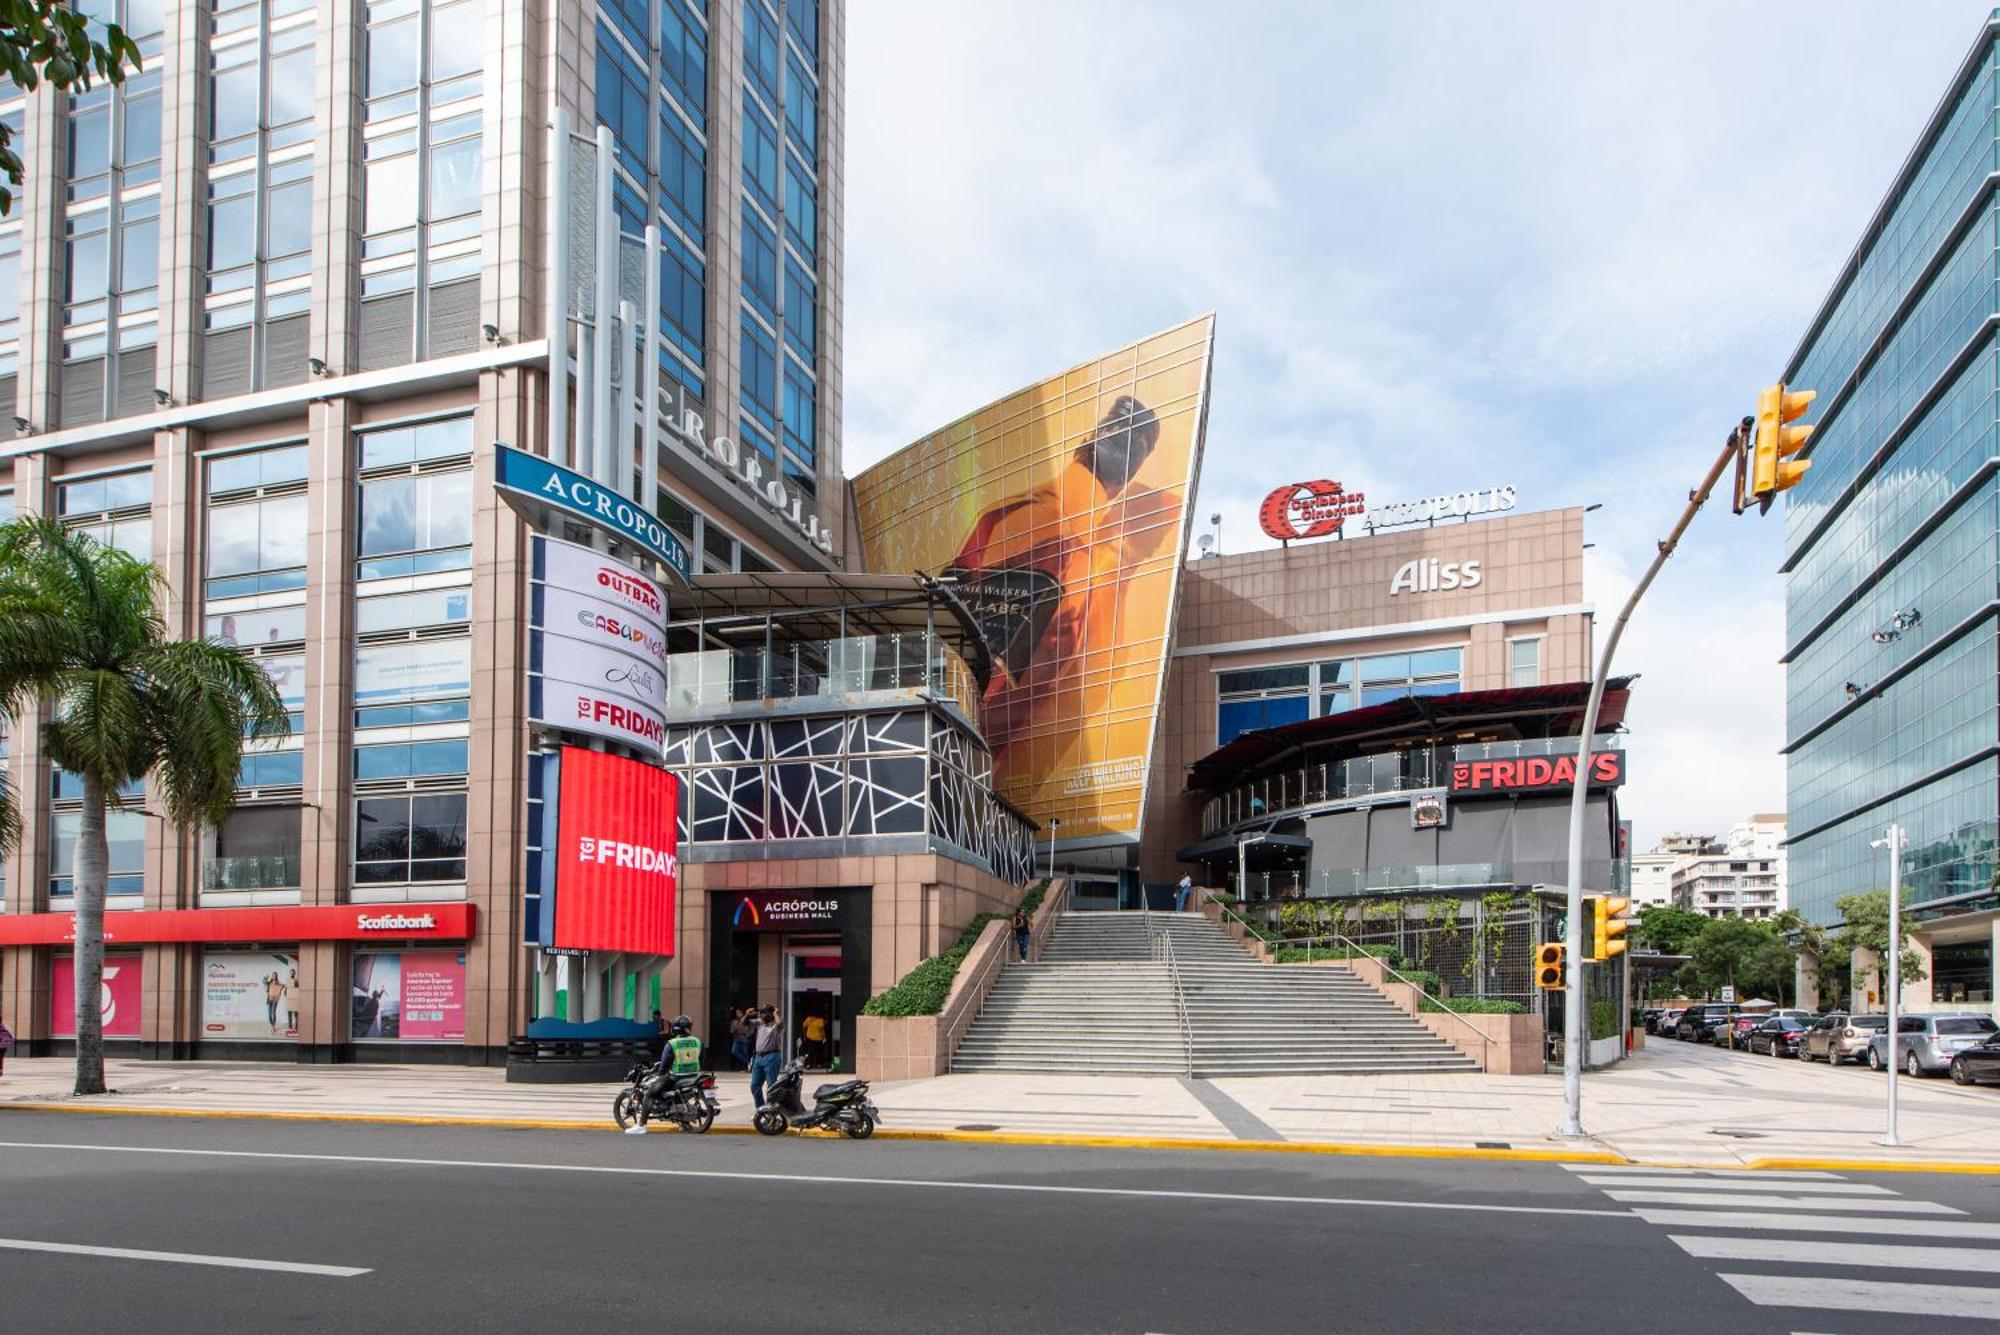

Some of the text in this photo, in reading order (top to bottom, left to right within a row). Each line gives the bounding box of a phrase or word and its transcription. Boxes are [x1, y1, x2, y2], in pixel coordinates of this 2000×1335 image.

[658, 386, 832, 553] CROPOLIS
[542, 472, 684, 570] ACROPOLIS
[1291, 492, 1365, 511] Caribbean
[1301, 504, 1365, 521] Cinemas
[1361, 486, 1517, 530] ACROPOLIS
[597, 573, 661, 616] OUTBACK
[984, 586, 1028, 597] WALKER
[1390, 556, 1483, 596] Aliss
[578, 696, 663, 745] TGI FRIDAYS
[1453, 763, 1470, 790] TGI
[580, 837, 677, 879] TGI FRIDAYS
[357, 914, 436, 929] Scotiabank
[764, 900, 838, 912] ACRÓPOLIS
